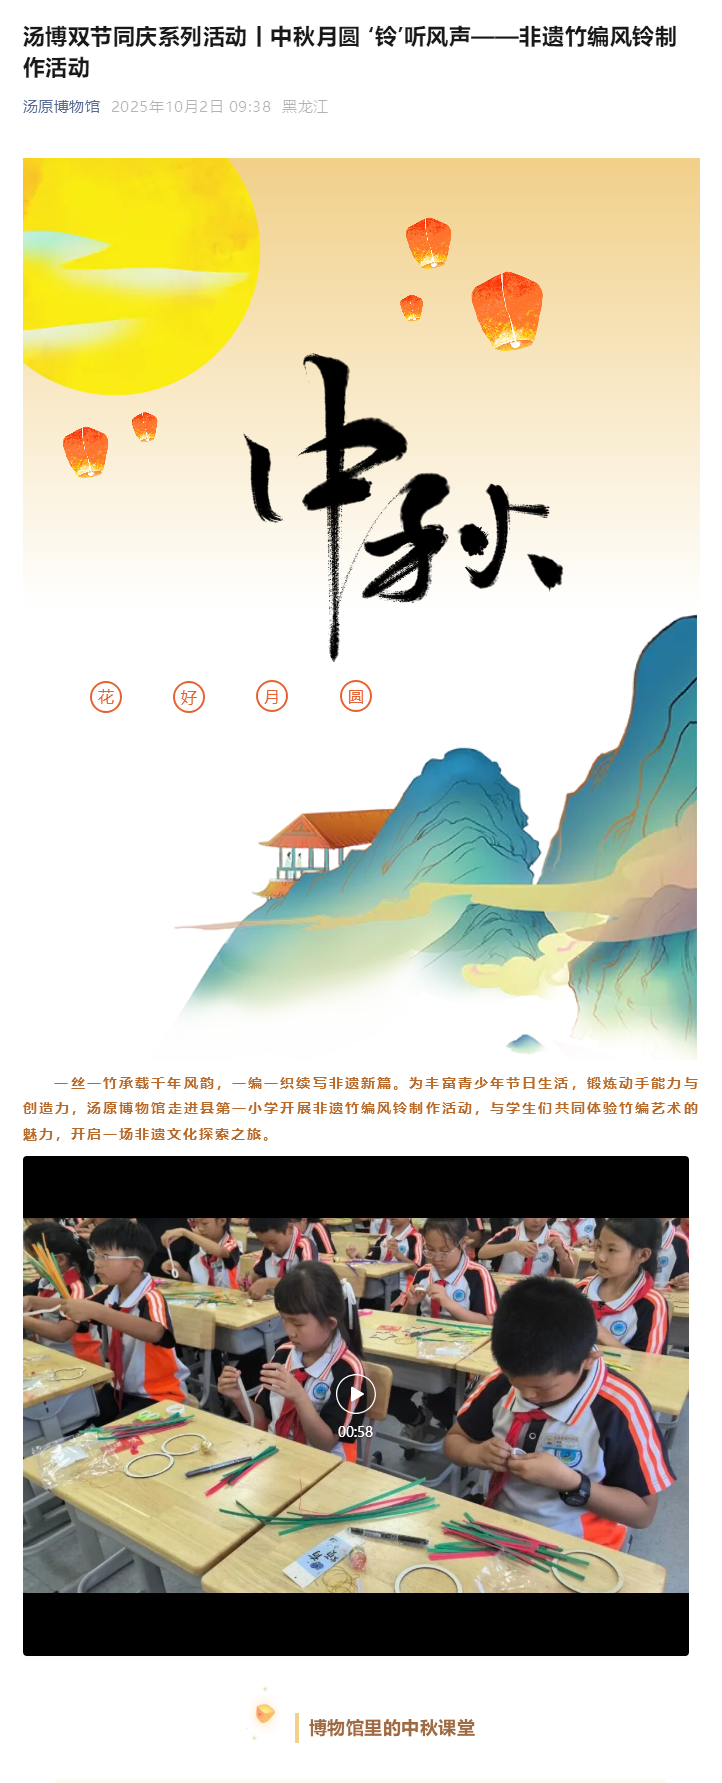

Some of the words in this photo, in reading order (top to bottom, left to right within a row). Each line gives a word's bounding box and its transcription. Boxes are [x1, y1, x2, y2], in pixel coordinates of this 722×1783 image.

[23, 56, 90, 79] 作活动
[22, 99, 101, 114] 汤原博物馆
[111, 99, 223, 114] 2025年10月2日
[229, 100, 271, 114] 09:38
[282, 99, 329, 114] 黑龙江
[243, 353, 564, 662] 中秋
[98, 689, 115, 705] 花
[180, 690, 198, 706] 好
[264, 689, 278, 705] 月
[348, 689, 364, 705] 圆
[53, 1076, 699, 1091] 一丝一竹承载千年风韵，一编一织续写非遗新篇。为丰富青少年节日生活，锻炼动手能力与
[22, 1101, 699, 1116] 创造力，汤原博物馆走进县第一小学开展非遗竹编风铃制作活动，与学生们共同体验竹编艺术的
[22, 1127, 269, 1142] 魅力，开启一场非遗文化探索之旅。
[309, 1719, 475, 1738] 博物馆里的中秋课堂
